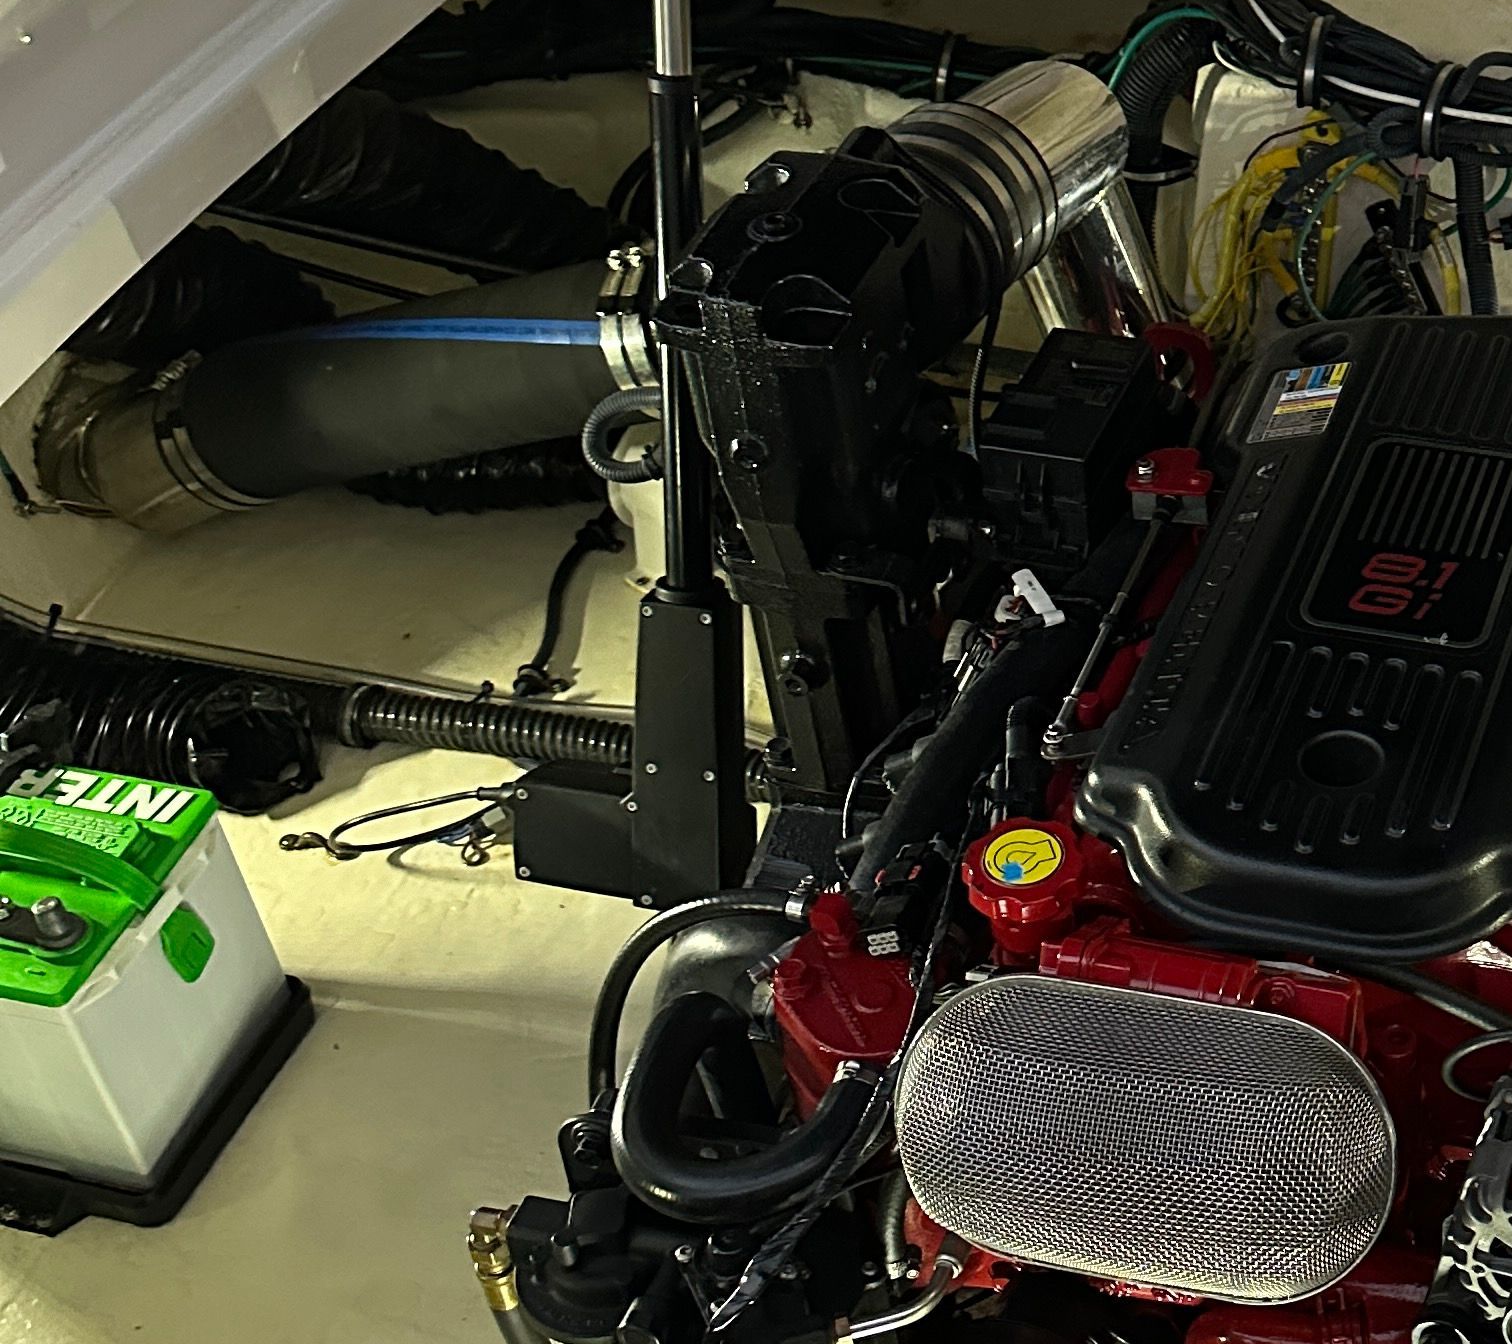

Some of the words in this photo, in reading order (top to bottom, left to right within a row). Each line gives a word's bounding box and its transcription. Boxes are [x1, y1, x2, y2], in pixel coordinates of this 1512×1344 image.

[1361, 551, 1460, 590] 8.1
[1347, 583, 1443, 621] Gi
[6, 768, 195, 824] INTER
